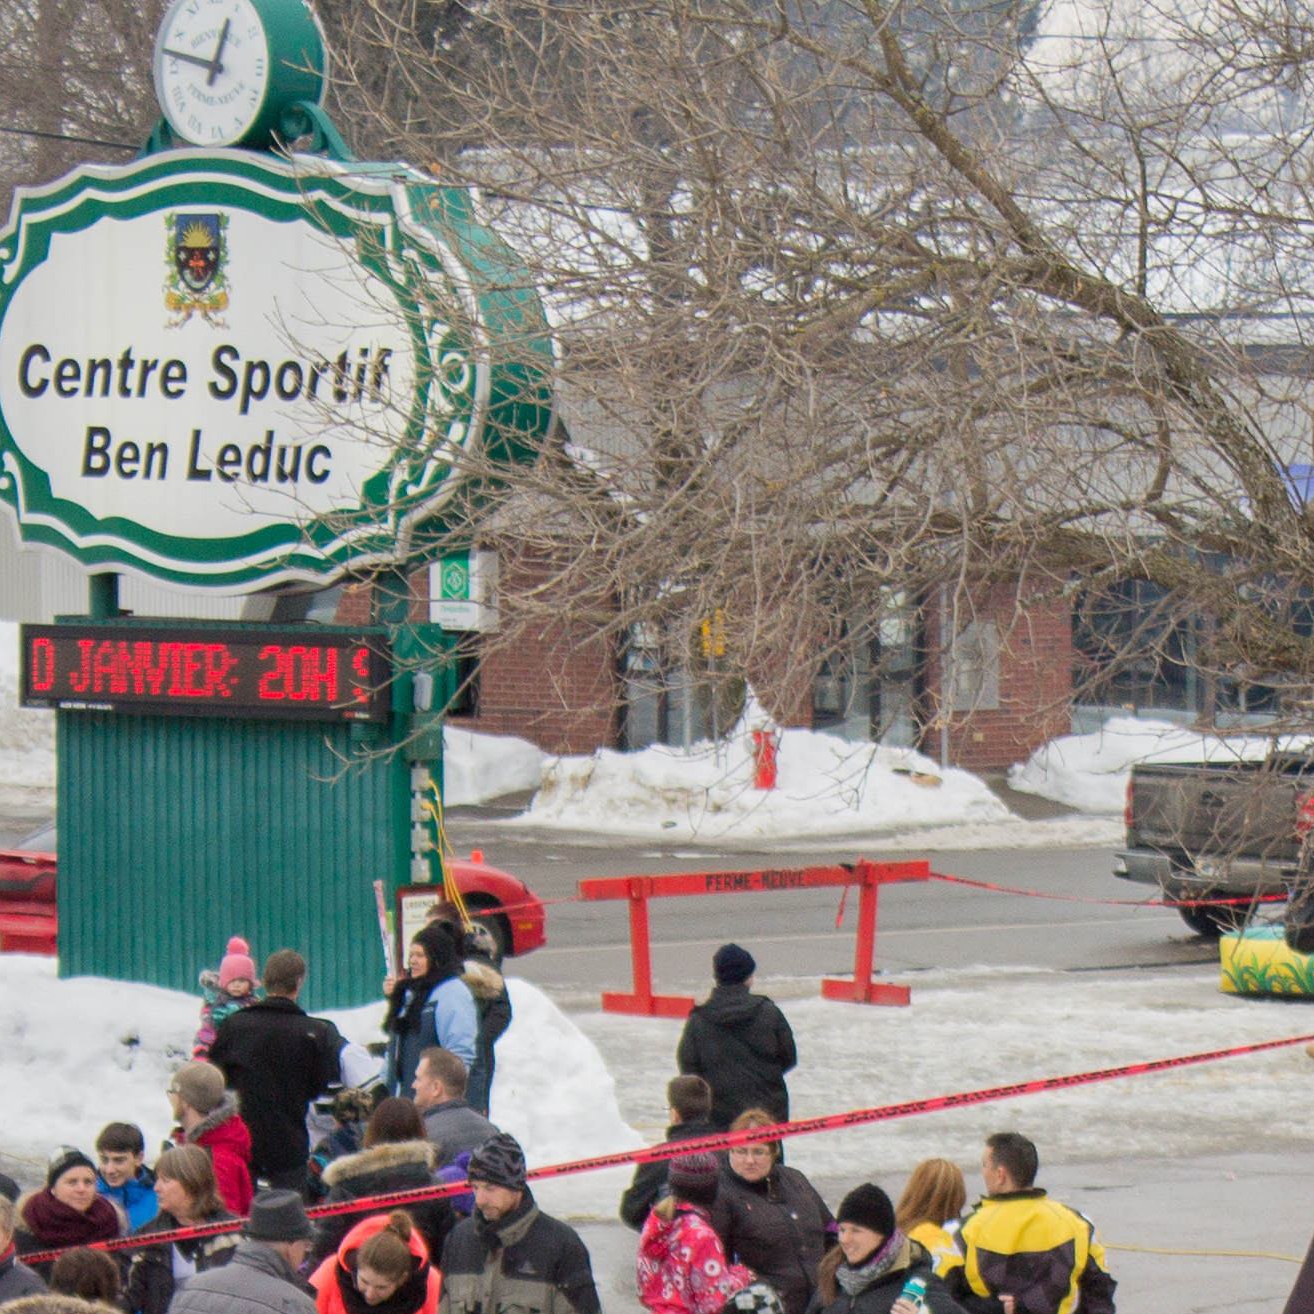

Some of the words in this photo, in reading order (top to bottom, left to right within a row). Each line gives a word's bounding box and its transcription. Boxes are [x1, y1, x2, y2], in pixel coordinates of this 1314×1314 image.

[18, 344, 187, 399] Centre
[207, 344, 392, 415] Sportif
[81, 426, 169, 480] Ben
[187, 429, 332, 484] Leduc
[259, 645, 337, 701] 20H
[706, 870, 805, 891] FERME-NEUVE
